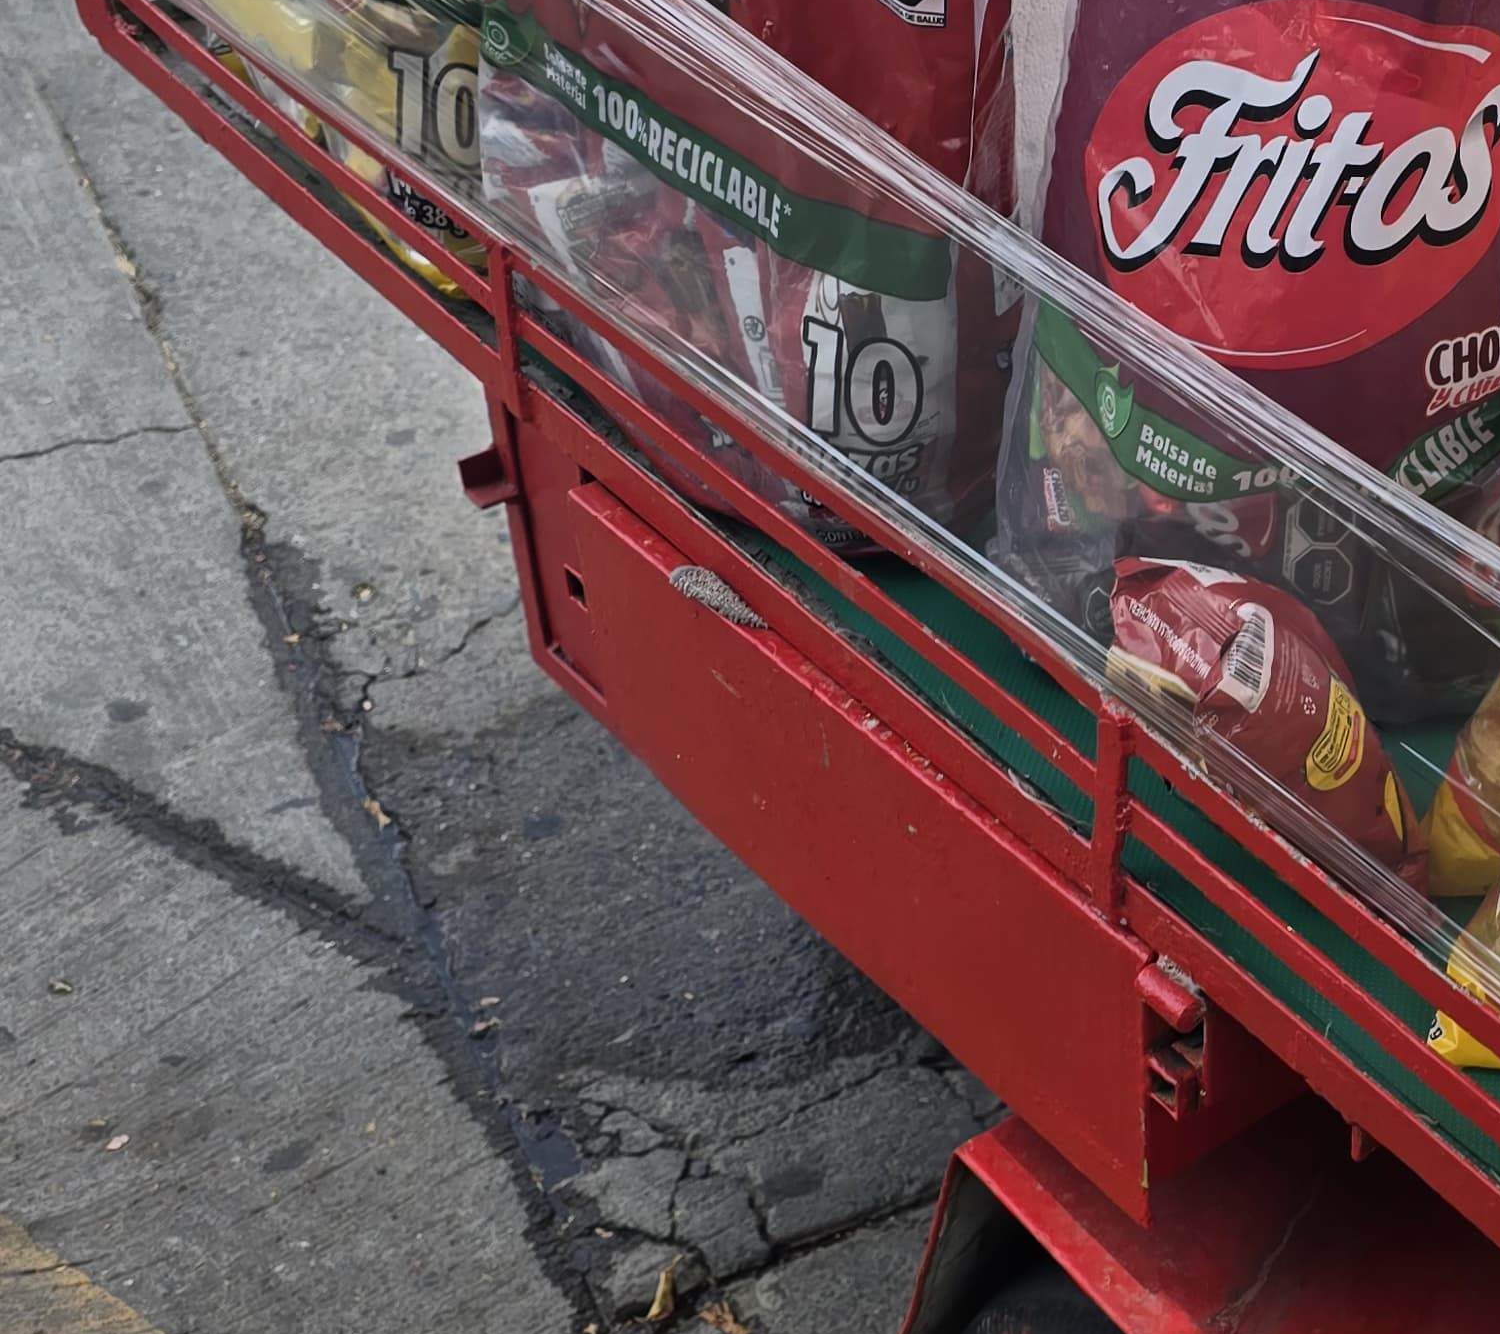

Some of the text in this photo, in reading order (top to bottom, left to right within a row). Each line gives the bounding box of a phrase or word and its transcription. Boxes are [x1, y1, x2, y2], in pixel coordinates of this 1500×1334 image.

[802, 315, 924, 448] 10
[1140, 424, 1218, 482] Bolsa de
